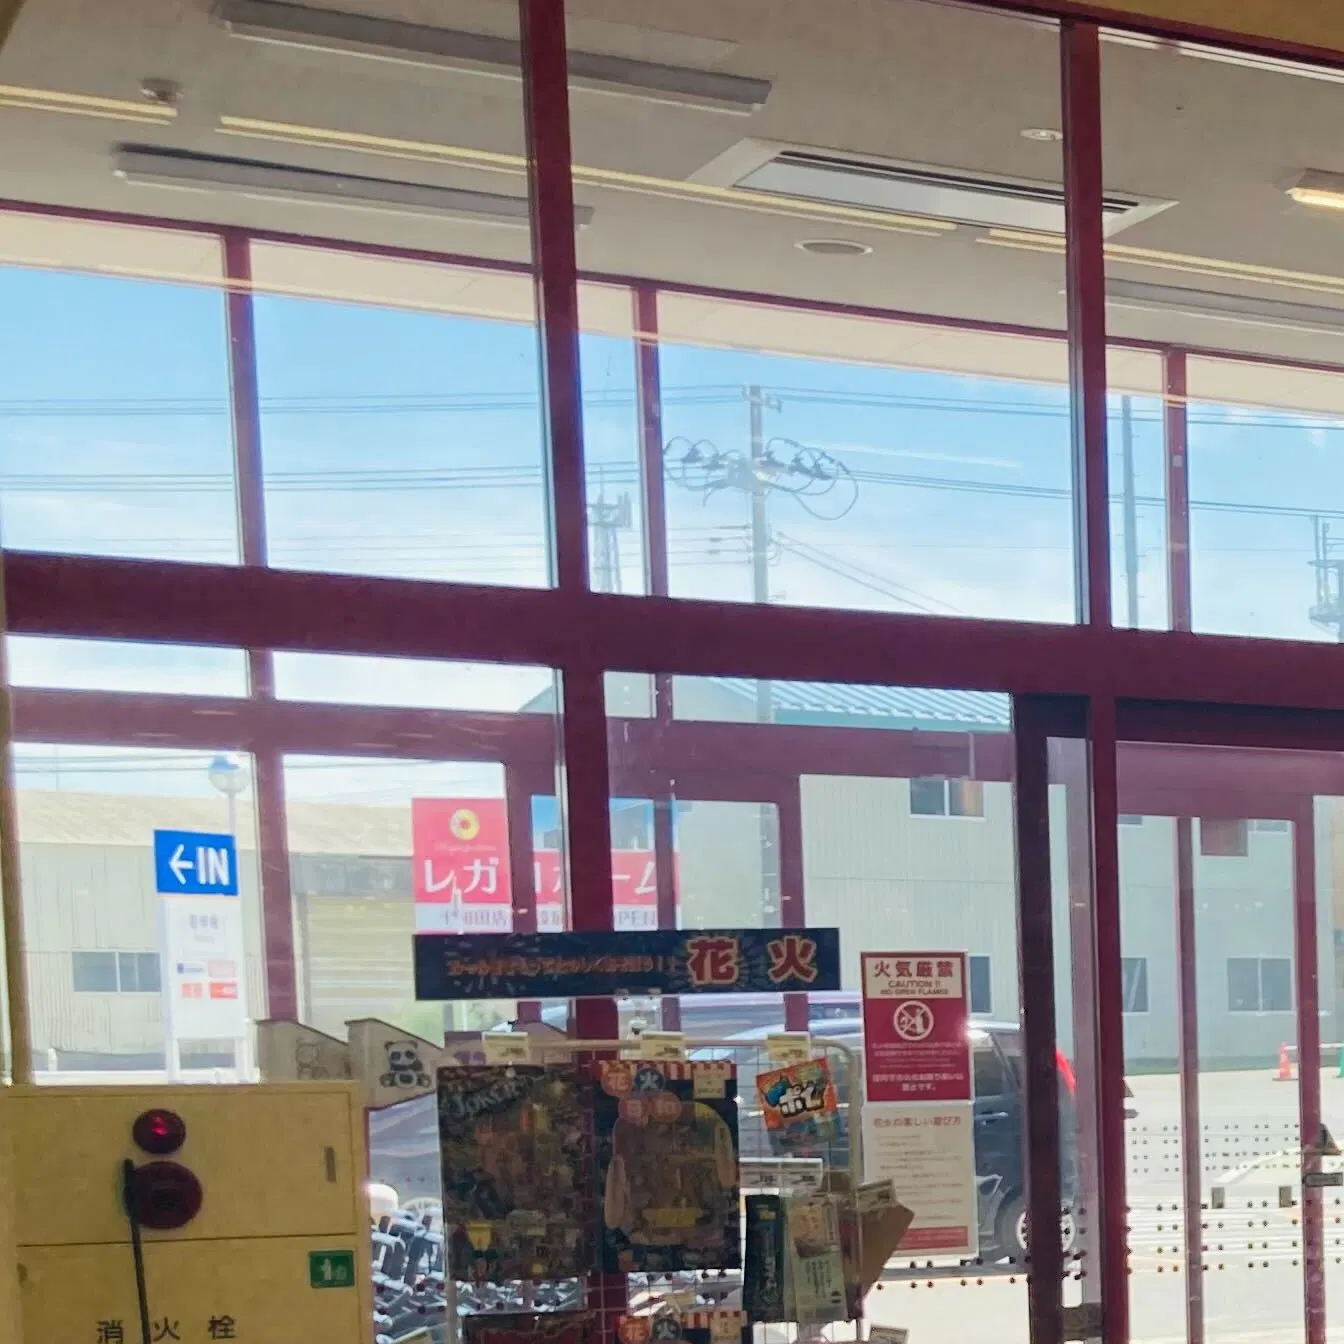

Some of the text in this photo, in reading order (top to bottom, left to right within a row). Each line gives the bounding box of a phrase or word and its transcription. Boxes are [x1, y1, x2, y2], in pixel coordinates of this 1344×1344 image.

[197, 846, 230, 885] IN
[687, 935, 819, 984] 花火
[874, 960, 953, 978] 火気厳禁
[888, 980, 932, 988] CAUTION
[96, 1315, 238, 1344] 消火栓
